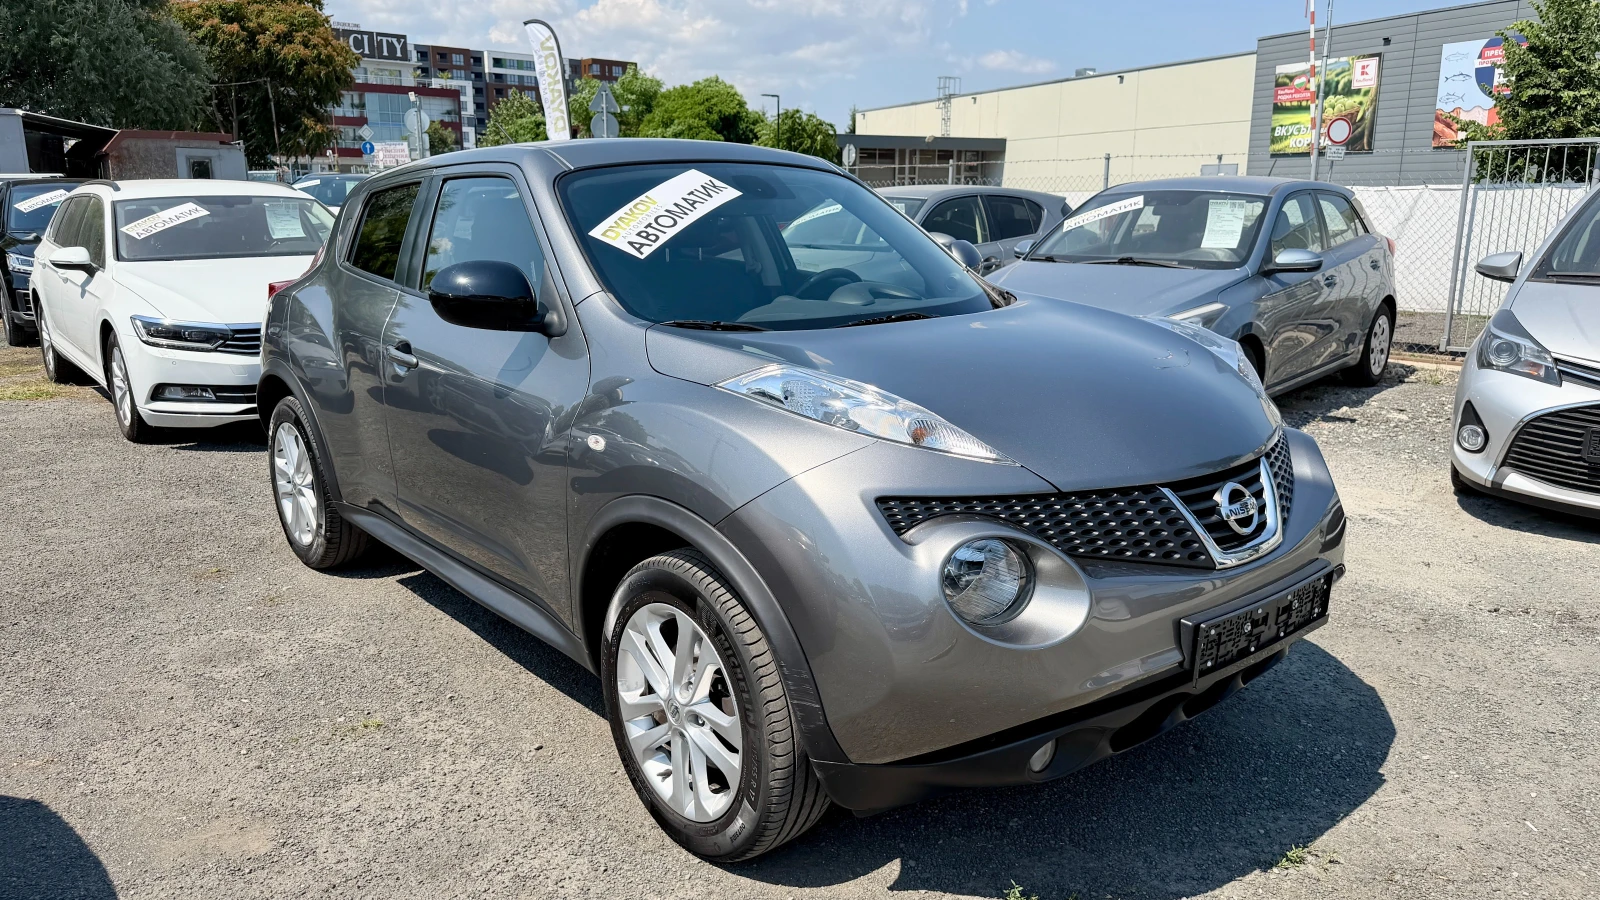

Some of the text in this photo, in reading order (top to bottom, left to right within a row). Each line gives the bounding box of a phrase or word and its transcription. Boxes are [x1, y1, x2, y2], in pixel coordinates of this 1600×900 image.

[349, 33, 405, 57] CITY
[1485, 48, 1505, 57] ПРЕС
[136, 206, 205, 239] АВТОМАТИК
[601, 195, 658, 241] DYAKOV
[622, 205, 664, 240] AUTOMOBILES
[627, 179, 729, 256] АВТОМАТИК
[1065, 199, 1142, 231] АВТОМАТИК
[716, 634, 755, 729] MICHELIN
